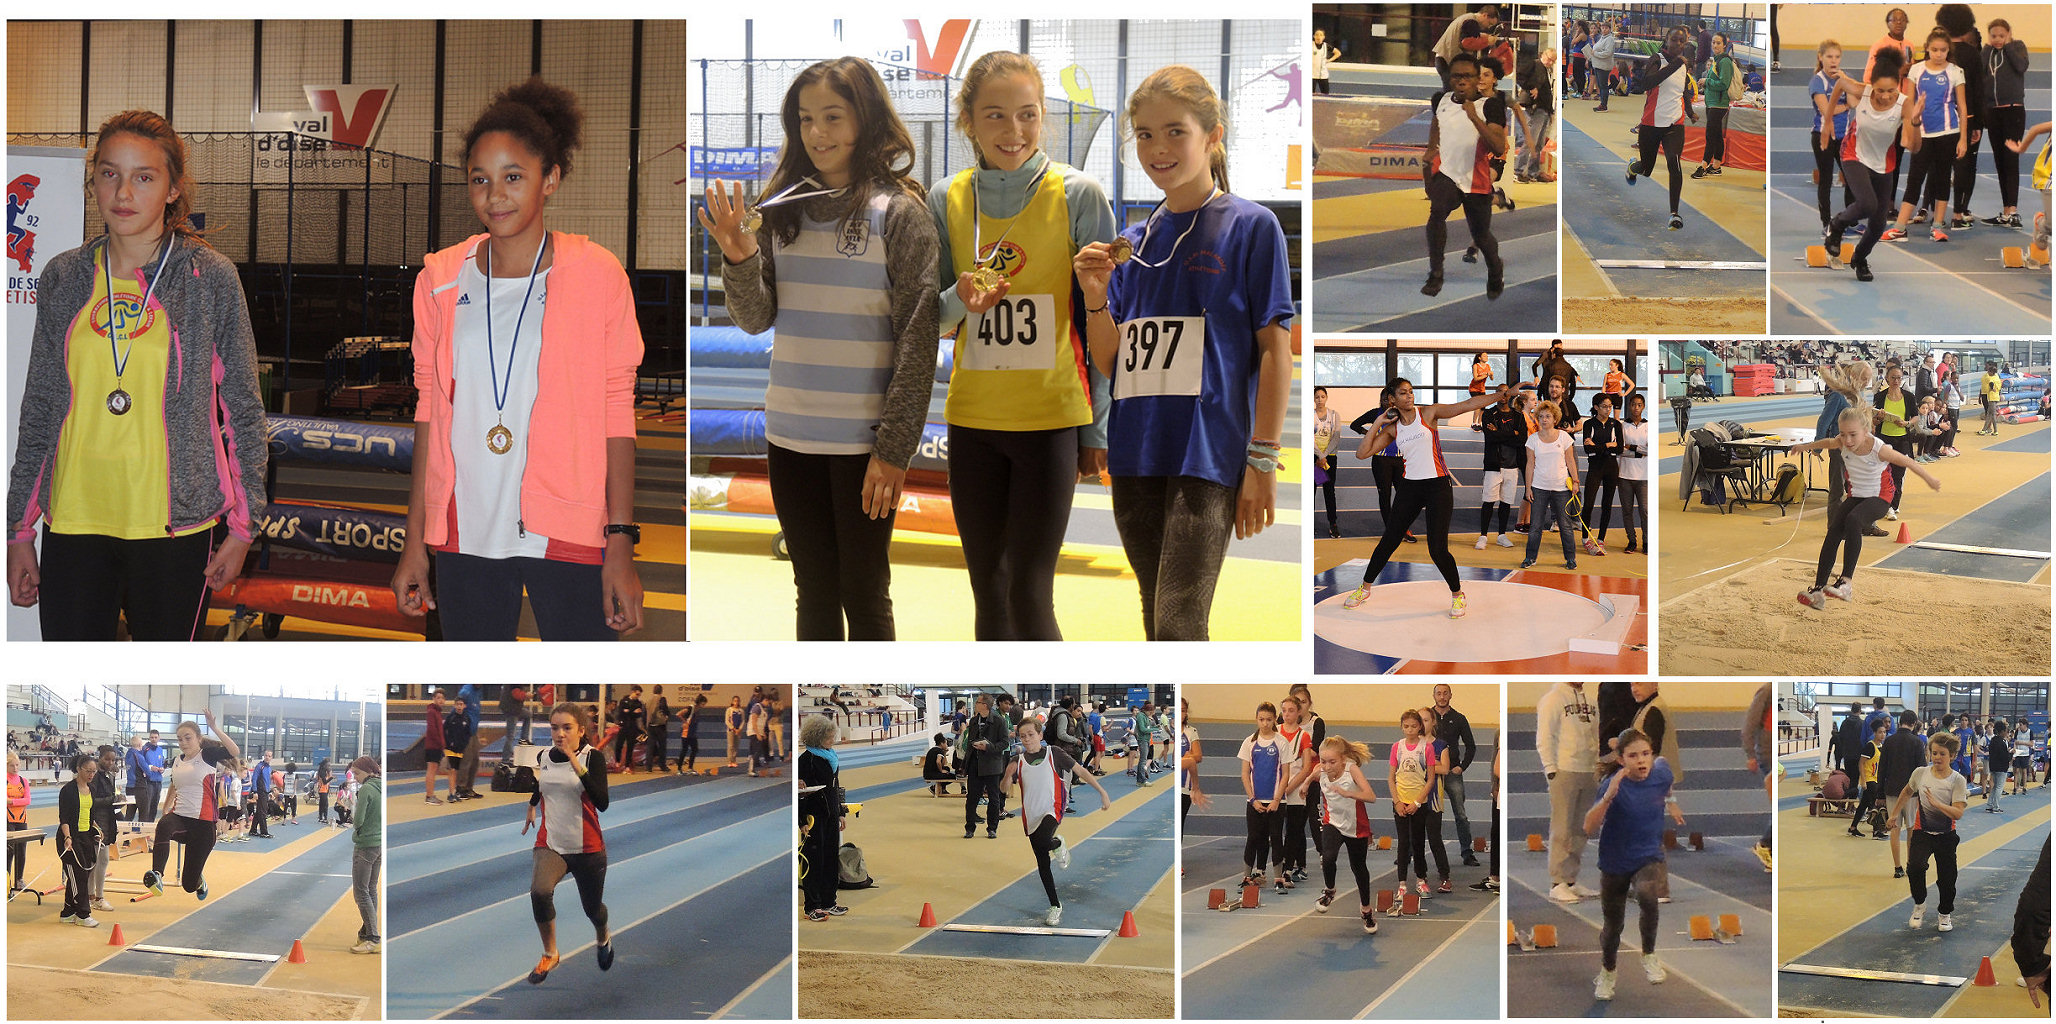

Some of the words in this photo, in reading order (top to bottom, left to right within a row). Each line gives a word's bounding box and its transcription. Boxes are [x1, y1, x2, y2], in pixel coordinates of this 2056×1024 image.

[876, 45, 910, 62] val
[293, 115, 327, 132] val
[256, 156, 270, 169] le
[1369, 156, 1419, 167] DIMA
[26, 214, 40, 227] 92
[977, 298, 1037, 347] 403
[1125, 320, 1185, 373] 397
[286, 419, 340, 431] VAULTING
[302, 429, 396, 457] UCS
[315, 519, 407, 552] SPORT
[292, 584, 371, 608] DIMA
